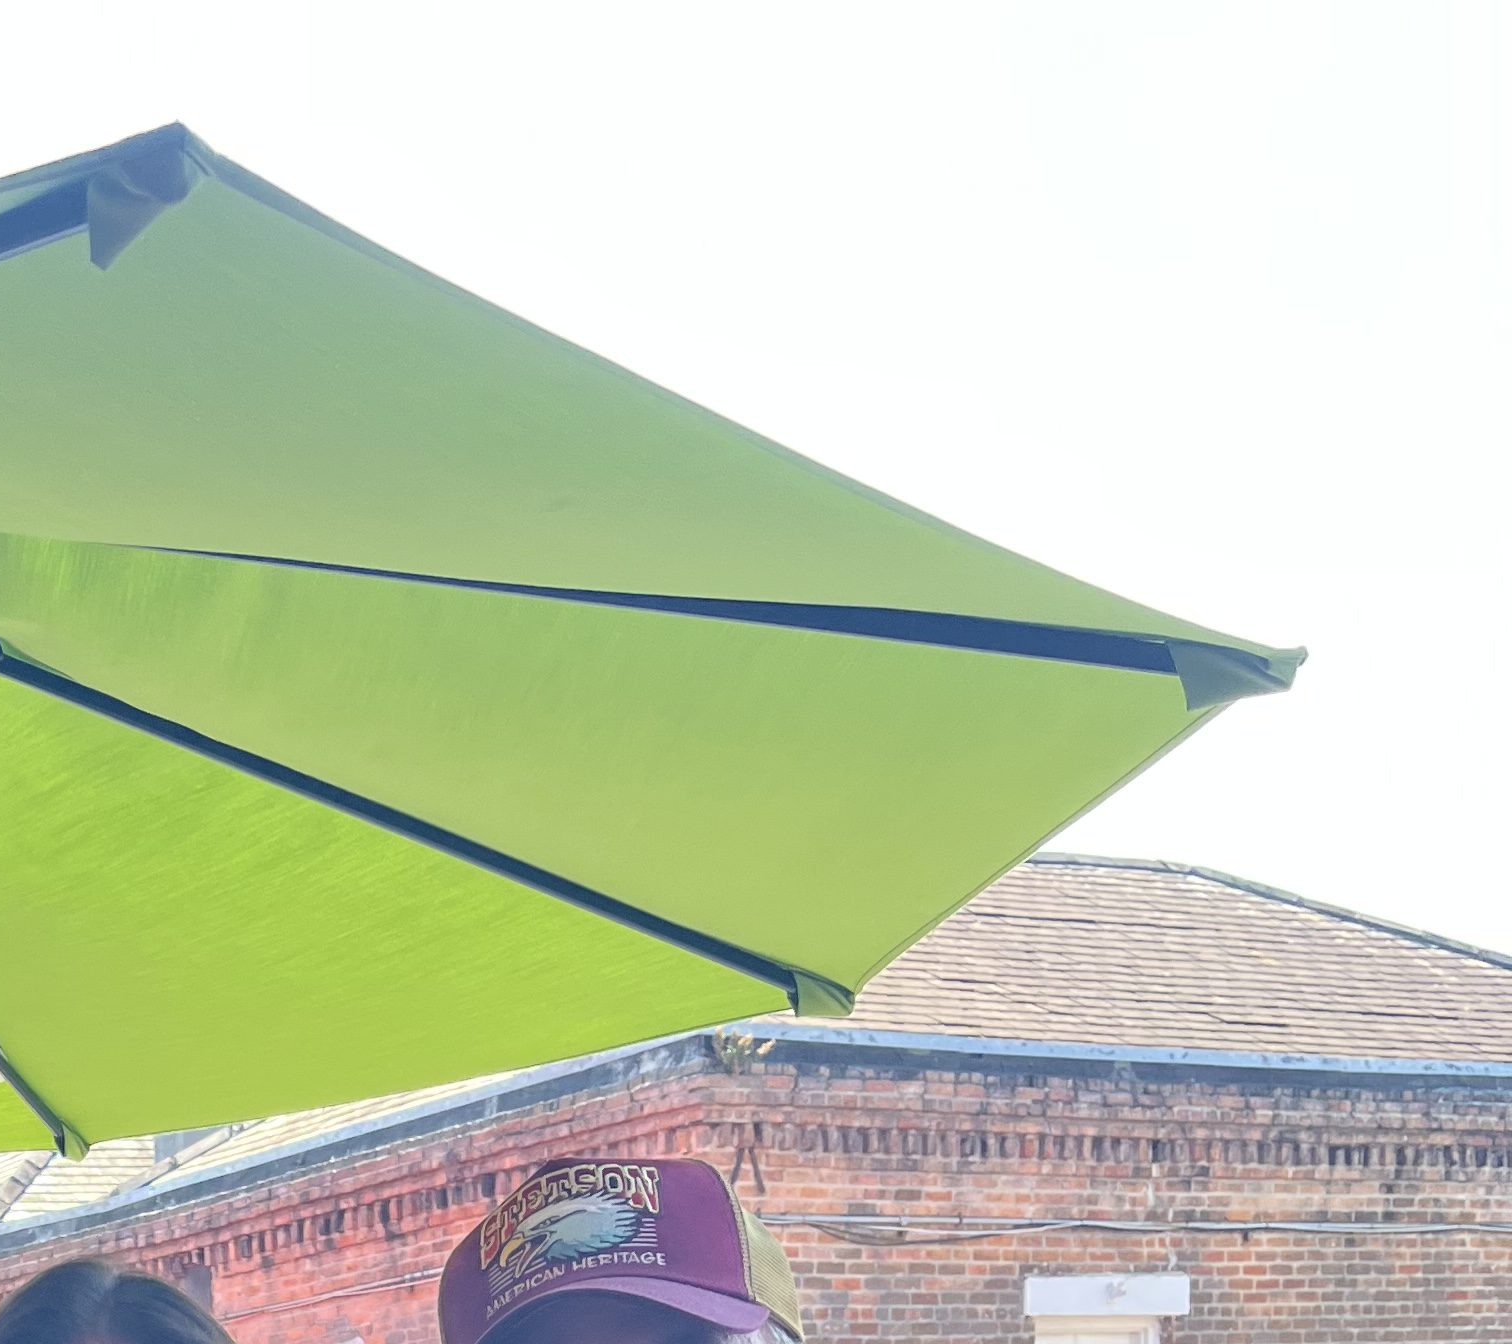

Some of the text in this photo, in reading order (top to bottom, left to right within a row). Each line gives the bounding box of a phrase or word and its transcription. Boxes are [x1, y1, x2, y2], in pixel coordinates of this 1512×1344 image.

[480, 1163, 660, 1271] STETSON
[485, 1251, 667, 1320] AMERICAN HERITAGE
